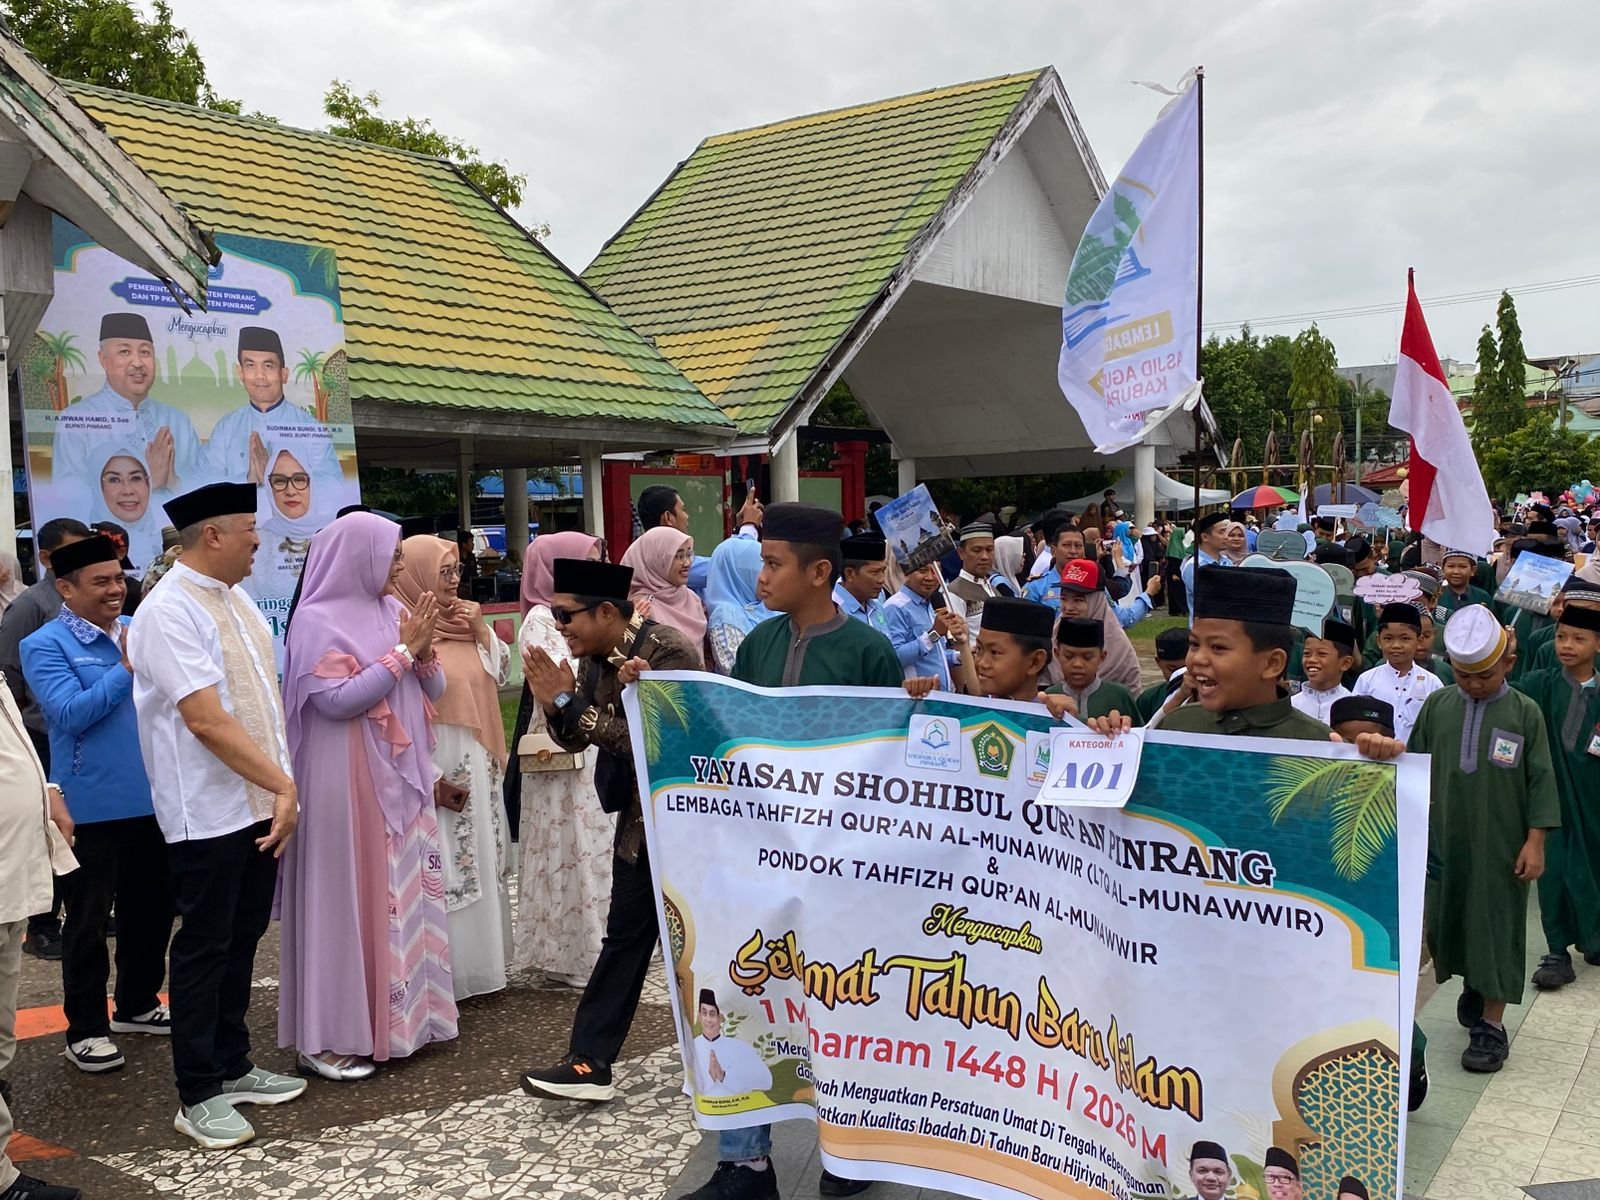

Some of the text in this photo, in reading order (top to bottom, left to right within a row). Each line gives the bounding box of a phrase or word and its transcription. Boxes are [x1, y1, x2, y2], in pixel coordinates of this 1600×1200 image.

[128, 283, 178, 293] PEMERINT
[223, 292, 256, 302] PINRANG
[222, 301, 255, 310] PINRANG
[168, 316, 227, 339] Mengucapkan
[1051, 762, 1123, 790] A01
[1069, 740, 1113, 749] KATEGORI
[692, 757, 1274, 886] YAYASAN SHOHIBUL QUR'AN PINRANG
[666, 794, 1325, 938] LEMBAGA TAHFIZH QUR'AN AL-MUNAWWIR (LTQ AL-MUNAWWIR)
[986, 857, 999, 875] &
[758, 848, 1158, 965] PONDOK TAHFIZH QUR'AN AL-MUNAWWIR
[923, 902, 1042, 955] Mengucapkan
[884, 951, 1021, 1042] Tahun
[1026, 976, 1109, 1071] Baru
[1108, 1014, 1203, 1122] Islam
[760, 1000, 775, 1024] 1
[785, 998, 931, 1068] Mharram
[944, 1040, 1026, 1089] 1448
[1037, 1063, 1059, 1099] H
[1083, 1085, 1136, 1150] 2026
[1142, 1125, 1167, 1167] M
[842, 1081, 928, 1108] Menguatkan
[930, 1090, 999, 1123] Persatuan
[1003, 1108, 1037, 1133] Umat
[1041, 1119, 1055, 1140] Di
[1058, 1125, 1097, 1158] Tengah
[1099, 1144, 1165, 1194] Keberagaman
[860, 1109, 915, 1133] Kualitas
[919, 1116, 966, 1141] Ibadah
[969, 1128, 986, 1145] Di
[989, 1133, 1028, 1160] Tahun
[1031, 1149, 1061, 1171] Baru
[1063, 1157, 1108, 1192] Hijriyah
